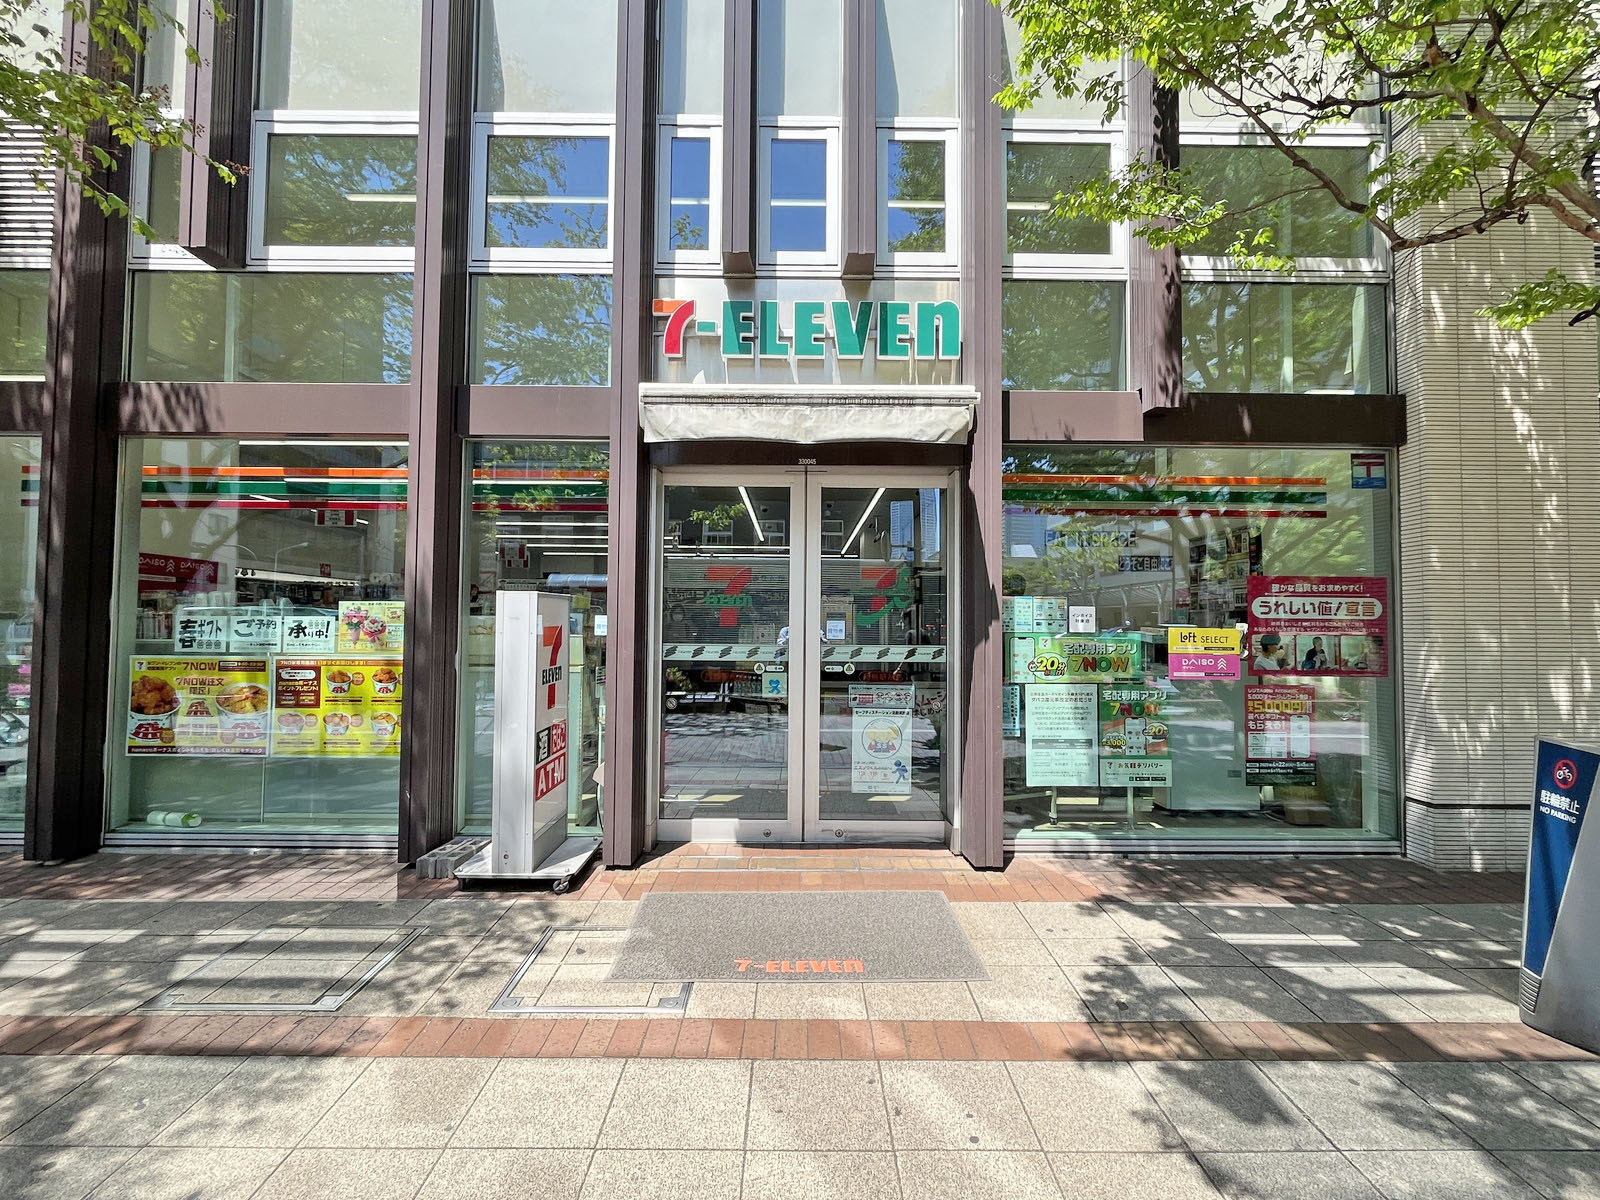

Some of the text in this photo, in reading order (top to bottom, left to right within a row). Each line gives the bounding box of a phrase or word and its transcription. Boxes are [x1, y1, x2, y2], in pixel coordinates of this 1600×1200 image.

[234, 618, 278, 638] ご予約
[288, 619, 330, 638] 承り中!
[1200, 635, 1229, 644] SELECT
[1063, 642, 1138, 655] 宅配専用アプリ
[182, 661, 217, 671] 7NOW
[1072, 656, 1130, 673] 7NOW
[1182, 658, 1215, 666] DAISO
[1102, 690, 1167, 701] 宅配専用アプリ
[1110, 702, 1161, 716] 7NOW
[538, 730, 549, 762] 酒
[537, 755, 565, 797] ATM
[1540, 789, 1580, 815] 駐輪禁止
[1540, 805, 1577, 824] NO PARKING
